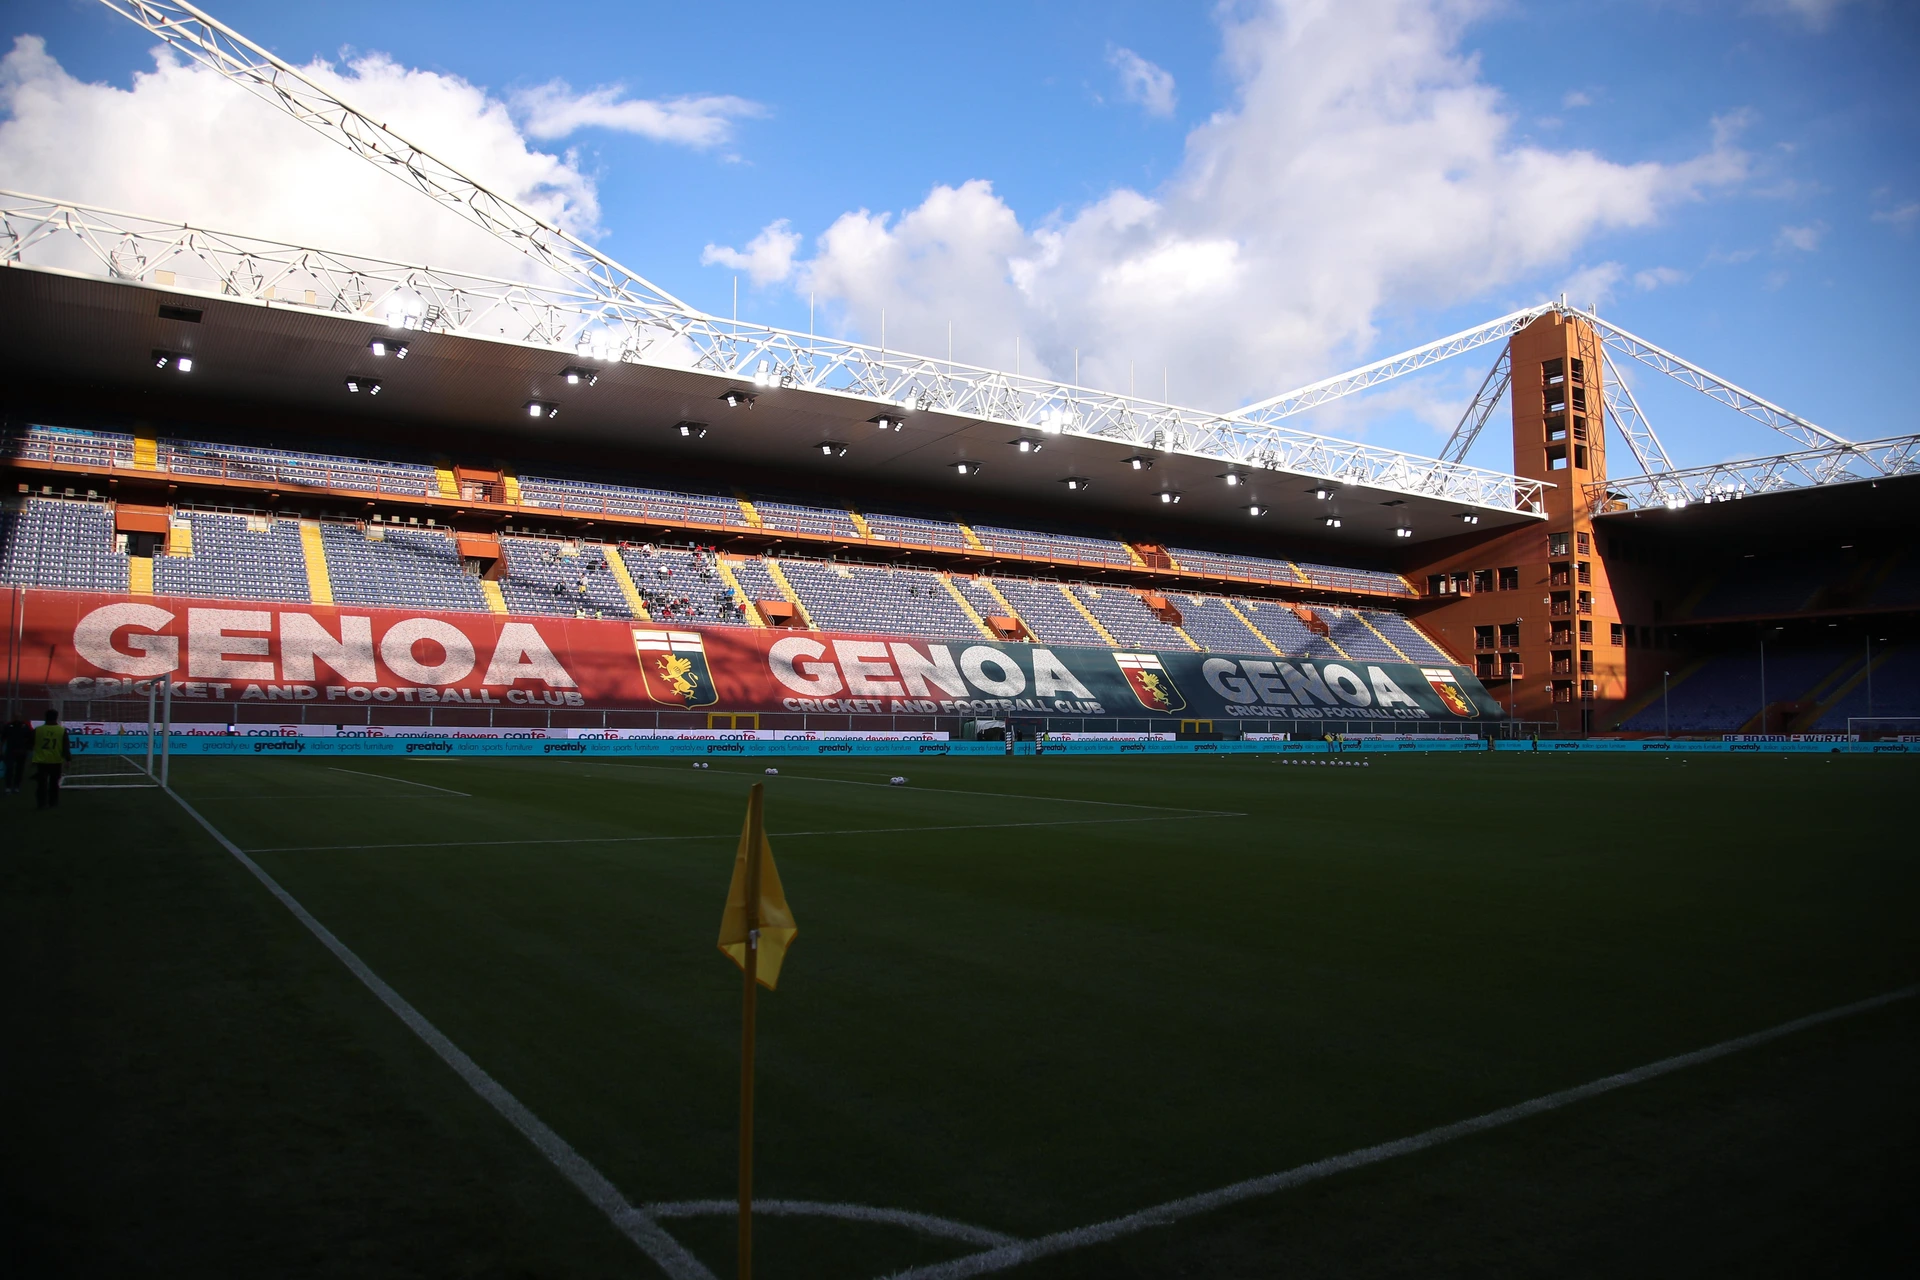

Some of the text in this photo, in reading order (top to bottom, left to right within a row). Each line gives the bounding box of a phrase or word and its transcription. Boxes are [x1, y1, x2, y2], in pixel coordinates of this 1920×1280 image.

[73, 602, 578, 687] GENOA
[768, 637, 1096, 699] GENOA
[1202, 658, 1420, 707] GENOA
[68, 677, 585, 707] CRICKET AND FOOTBALL CLUB
[782, 697, 1105, 715] CRICKET AND FOOTBALL CLUB
[1225, 705, 1430, 719] CRICKET AND FOOTBALL CLUB
[42, 738, 58, 749] 21
